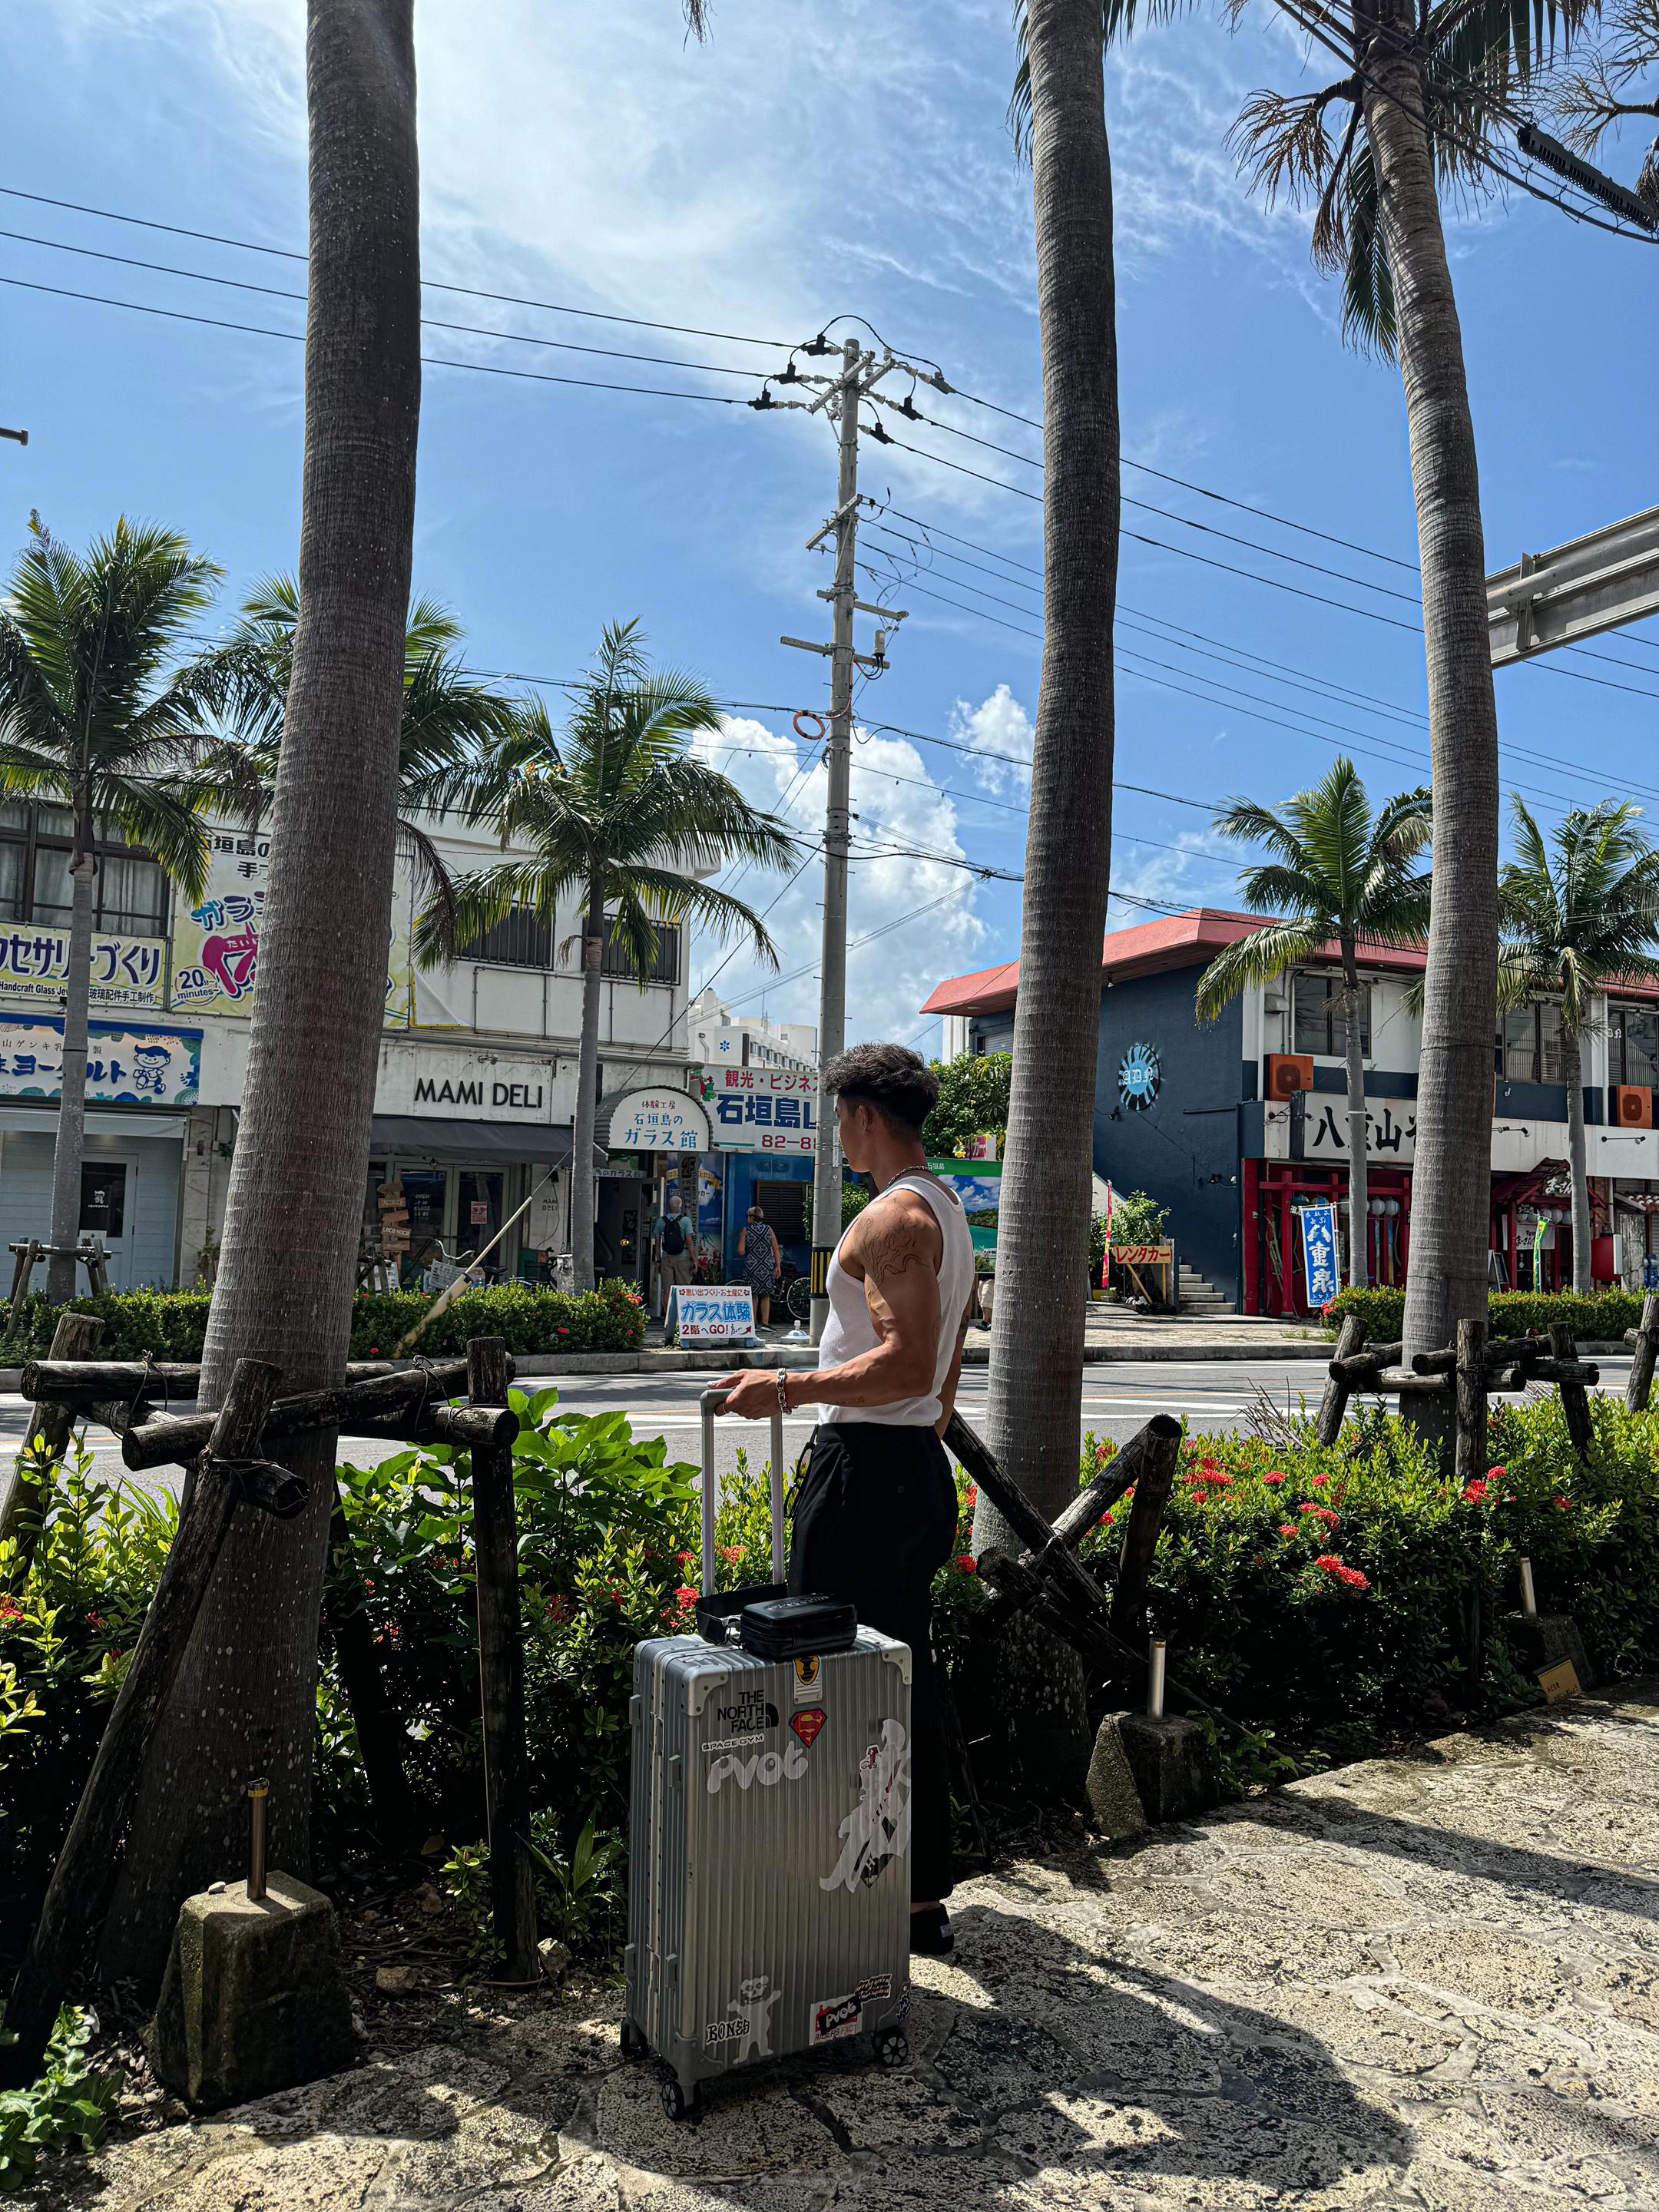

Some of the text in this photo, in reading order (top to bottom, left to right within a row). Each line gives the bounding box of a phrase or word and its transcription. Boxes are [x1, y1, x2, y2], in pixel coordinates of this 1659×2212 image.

[0, 980, 34, 994] Handcraft
[35, 985, 55, 995] Glass
[415, 1078, 542, 1108] MAMI DELI
[641, 1100, 676, 1110] 体験工房
[634, 1113, 683, 1126] 石垣島の
[624, 1128, 699, 1149] ガラス館
[761, 1134, 816, 1150] 82-8
[1116, 1246, 1171, 1264] レンタカー
[681, 1301, 752, 1322] ガラス体験
[738, 1689, 764, 1705] THE
[717, 1702, 764, 1721] NORTH
[730, 1717, 764, 1734] FACE
[702, 1734, 764, 1752] SPACE GYM
[707, 2019, 750, 2042] BONES
